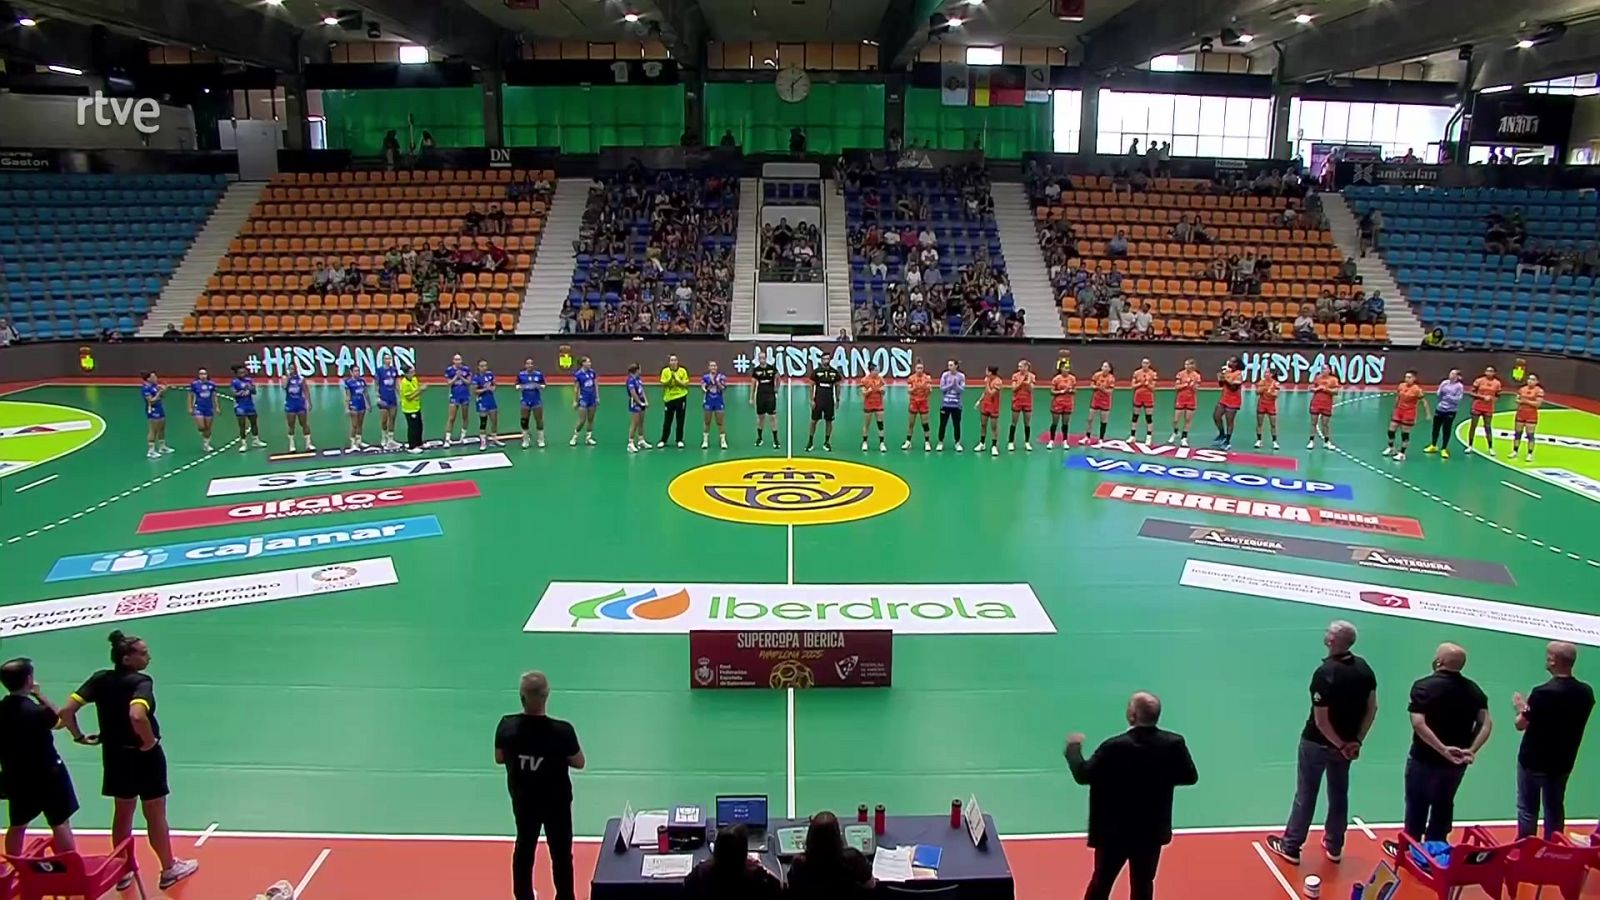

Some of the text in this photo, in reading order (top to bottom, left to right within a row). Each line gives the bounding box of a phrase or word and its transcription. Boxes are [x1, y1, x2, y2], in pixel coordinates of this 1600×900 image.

[1, 158, 49, 166] Gaston
[489, 148, 511, 162] DN
[1376, 168, 1438, 180] amixalan
[1091, 439, 1229, 463] AVIS
[258, 457, 463, 487] sacyr
[228, 490, 405, 518] alfaloc
[338, 502, 374, 511] YOU
[1110, 485, 1312, 522] FERREIRA
[264, 507, 333, 520] ALWAYS
[185, 522, 406, 559] cajamar
[168, 582, 281, 600] Nafarroako
[166, 592, 268, 608] Gobernua
[708, 597, 1016, 620] Iberdrola
[1, 605, 107, 623] Gobierno
[12, 613, 104, 630] Navarra
[737, 632, 800, 648] SUPERCOPA
[758, 649, 824, 660] PAMPLONA 2025
[518, 754, 545, 771] TV
